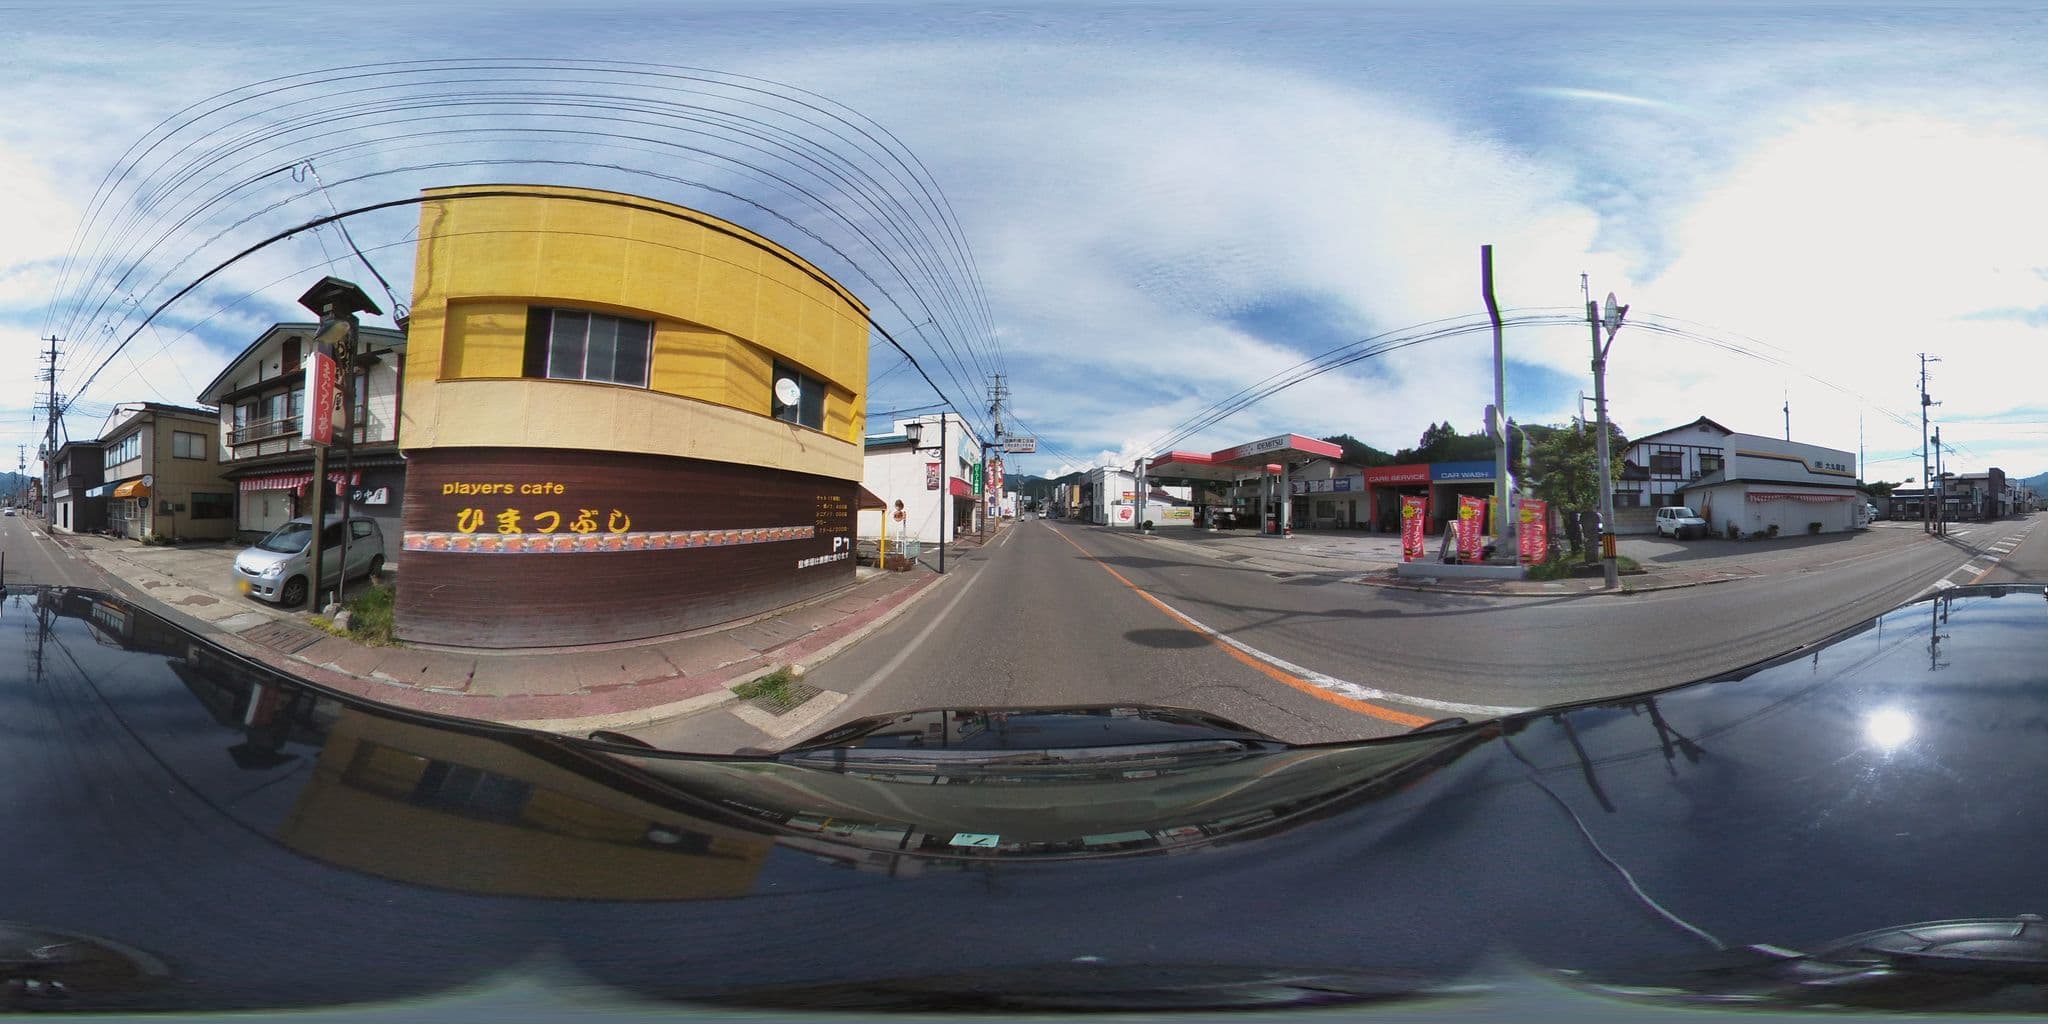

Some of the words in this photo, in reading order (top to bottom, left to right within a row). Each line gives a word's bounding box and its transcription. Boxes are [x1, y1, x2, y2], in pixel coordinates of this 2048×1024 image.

[1257, 438, 1284, 450] IDEMITSU
[443, 482, 515, 495] players
[520, 482, 566, 495] cafe
[456, 508, 631, 534] ひまつぶし
